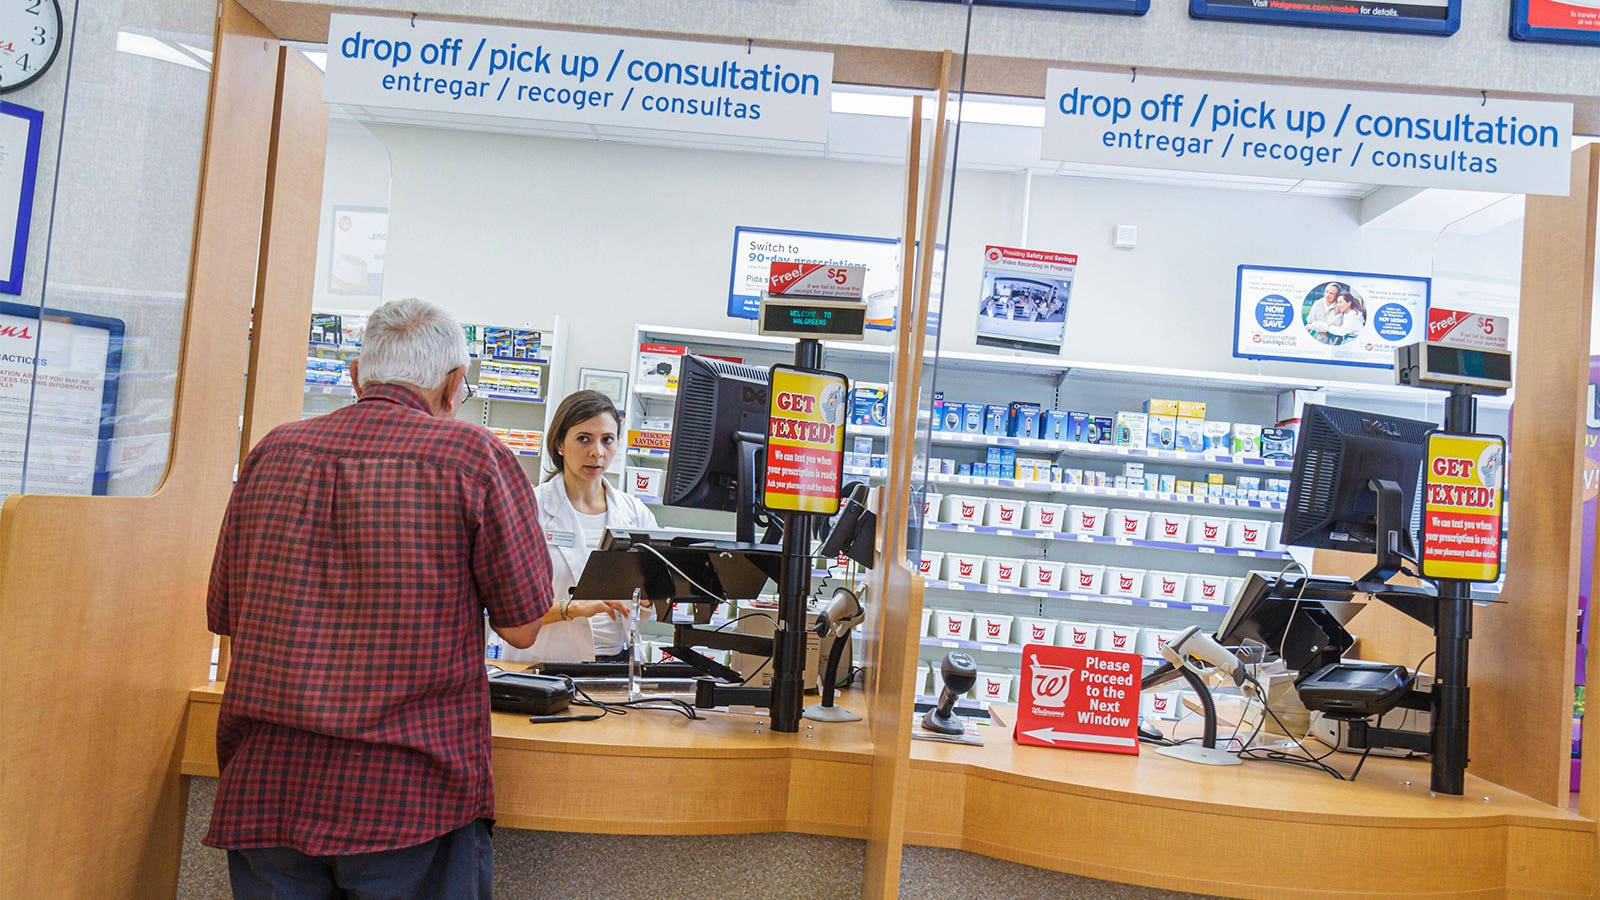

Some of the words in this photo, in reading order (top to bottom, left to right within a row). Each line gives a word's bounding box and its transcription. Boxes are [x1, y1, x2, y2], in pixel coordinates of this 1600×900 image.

[25, 0, 42, 15] 2
[1269, 1, 1359, 14] Walgreens.com/mobile
[1360, 6, 1371, 15] for
[1372, 7, 1399, 17] details.
[31, 26, 46, 46] 3
[15, 53, 31, 72] 4
[342, 32, 412, 68] drop
[420, 38, 463, 66] off
[489, 44, 551, 75] pick
[561, 54, 599, 83] up
[627, 60, 820, 97] consultation
[382, 72, 490, 100] entregar
[518, 85, 614, 111] recoger
[642, 96, 761, 120] consultas
[1059, 87, 1131, 124] drop
[1141, 93, 1184, 123] off
[1211, 99, 1275, 132] pick
[1286, 110, 1326, 138] up
[1355, 114, 1559, 148] consultation
[1103, 129, 1213, 157] entregar
[1243, 142, 1343, 166] recoger
[1372, 150, 1498, 174] consultas
[750, 241, 785, 253] Switch
[788, 244, 799, 254] to
[770, 264, 804, 287] Free!
[827, 267, 848, 285] $5
[1265, 305, 1285, 314] NOW
[1428, 311, 1457, 334] Free!
[1477, 316, 1495, 335] $5
[777, 392, 816, 414] GET
[769, 417, 836, 444] TEXTED!
[634, 437, 664, 447] SAVINGS
[775, 450, 784, 460] We
[784, 454, 794, 462] can
[795, 453, 806, 463] text
[806, 456, 817, 465] you
[817, 456, 832, 465] when
[767, 466, 781, 476] your
[781, 467, 815, 479] prescription
[815, 469, 821, 479] is
[1433, 457, 1474, 478] GET
[1426, 483, 1495, 509] TEXTED!
[1431, 517, 1441, 527] We
[1441, 519, 1451, 528] can
[1451, 519, 1464, 529] text
[1464, 521, 1476, 531] you
[1475, 520, 1493, 531] when
[1425, 533, 1439, 543] your
[1439, 533, 1475, 545] prescription
[1474, 535, 1480, 545] is
[1086, 657, 1131, 672] Please
[1080, 670, 1133, 686] Proceed
[1086, 685, 1100, 697] to
[1103, 686, 1125, 699] the
[1089, 699, 1120, 713] Next
[1077, 711, 1131, 728] Window
